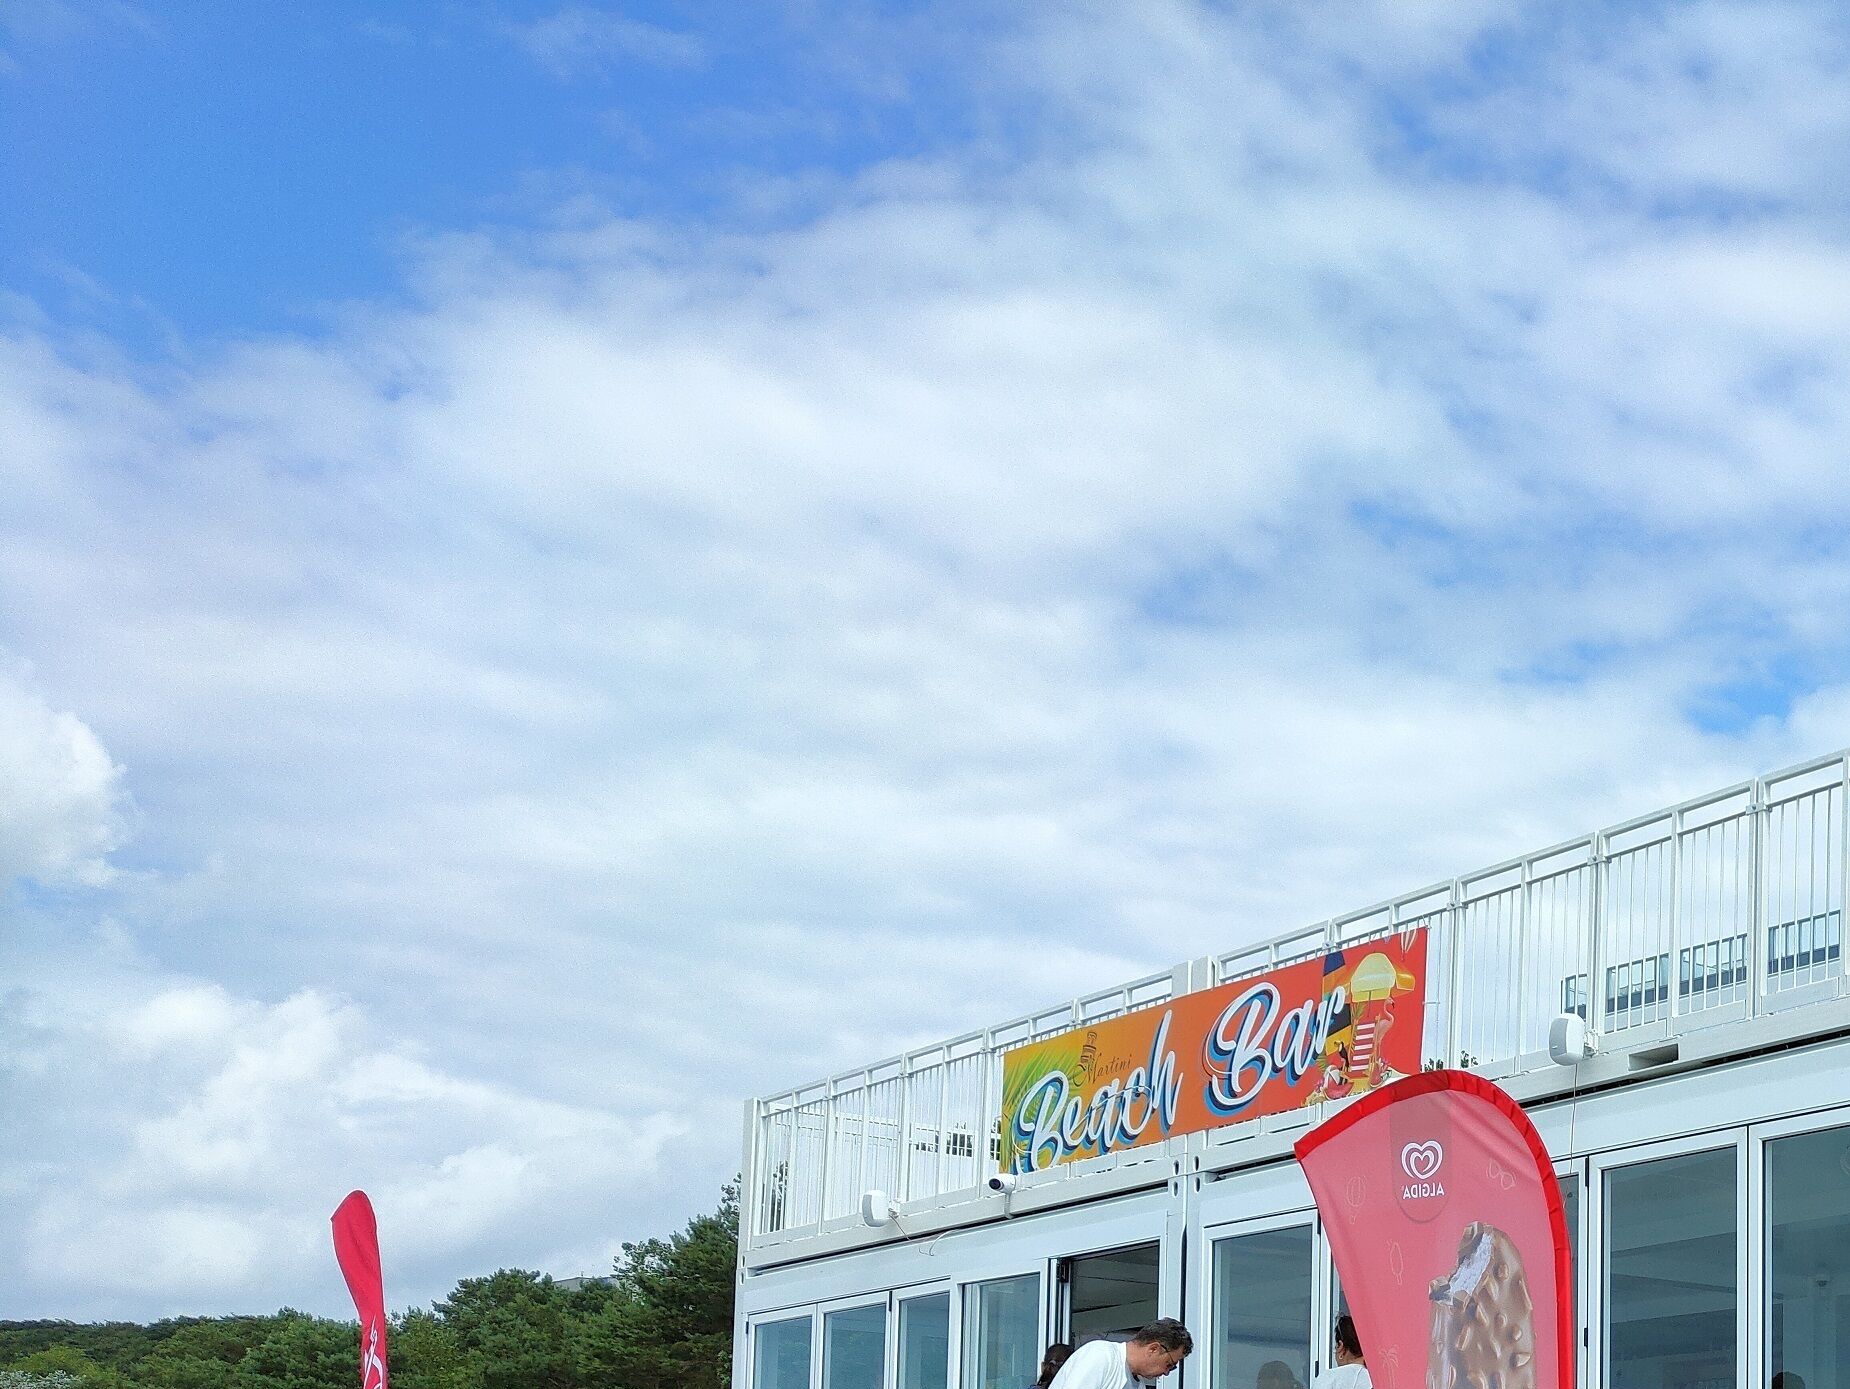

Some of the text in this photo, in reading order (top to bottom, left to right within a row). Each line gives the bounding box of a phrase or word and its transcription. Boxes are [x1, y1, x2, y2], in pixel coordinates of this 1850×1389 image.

[1011, 981, 1346, 1175] Beach Bar
[1072, 1053, 1132, 1087] Martini
